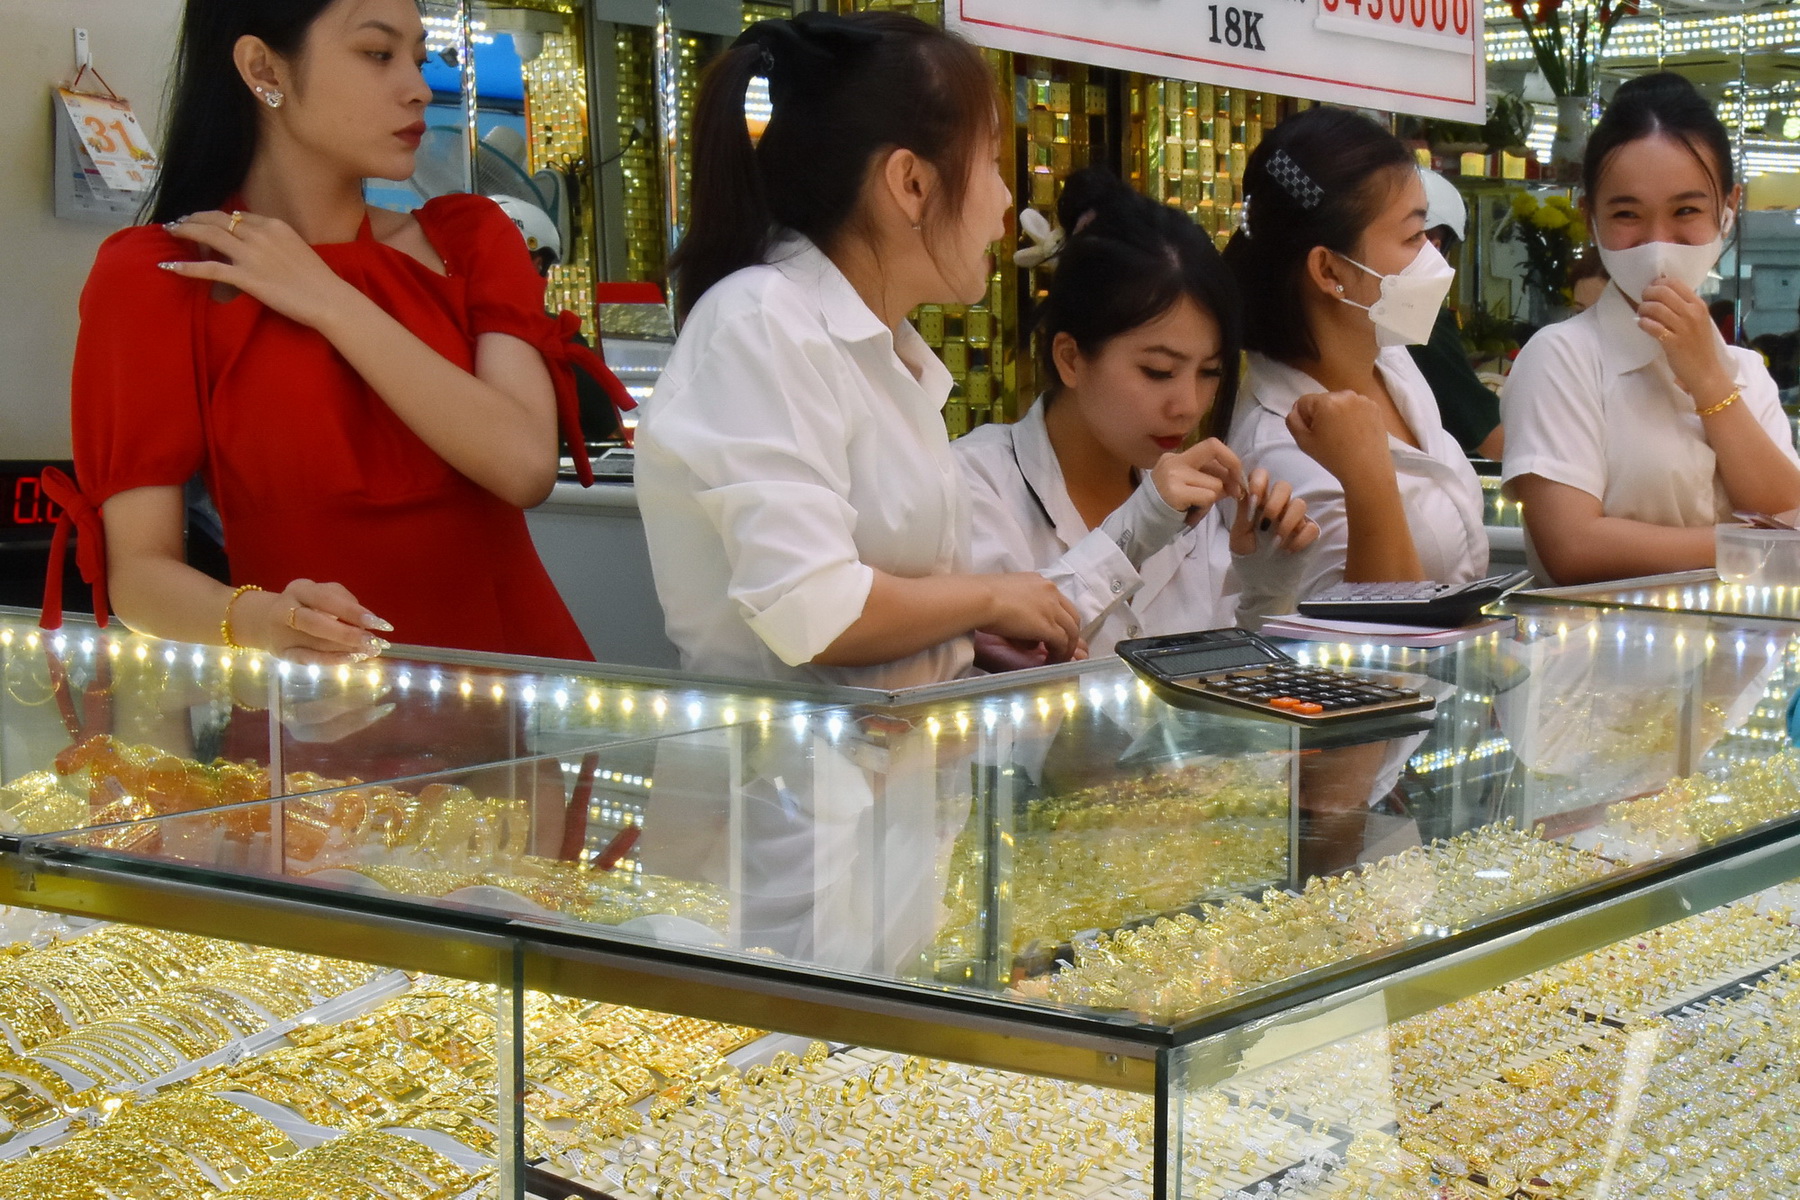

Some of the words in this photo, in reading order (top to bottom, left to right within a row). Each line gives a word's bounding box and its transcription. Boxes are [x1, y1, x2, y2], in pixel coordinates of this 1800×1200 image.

[1208, 5, 1266, 50] 18K
[1323, 0, 1468, 35] 0000
[84, 116, 138, 157] 31
